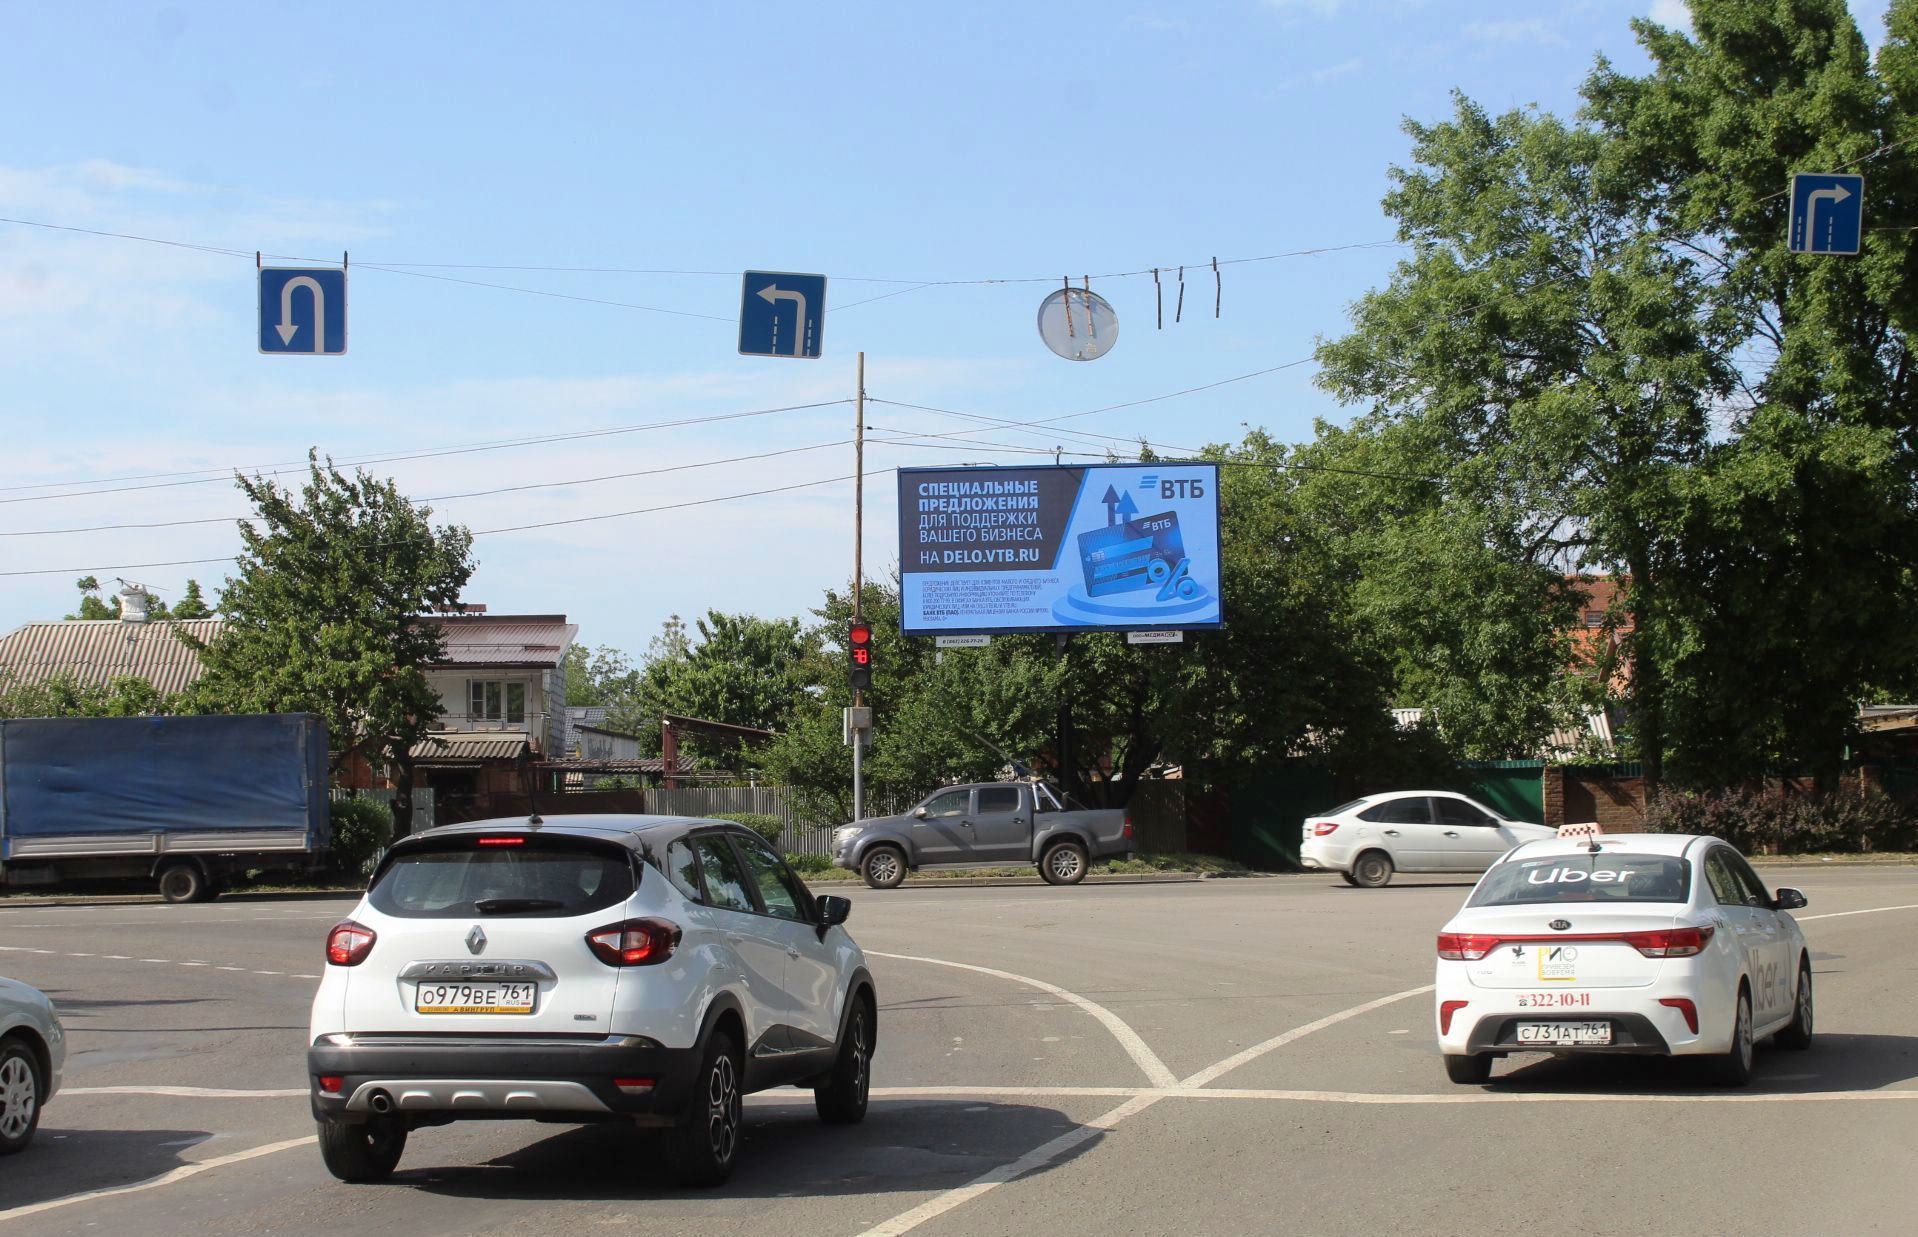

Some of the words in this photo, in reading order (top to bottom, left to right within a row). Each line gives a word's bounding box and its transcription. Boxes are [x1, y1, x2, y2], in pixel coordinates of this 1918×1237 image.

[918, 480, 1038, 497] СПЕЦИАЛЬНЫЕ
[1161, 479, 1204, 499] ВТБ
[918, 496, 1039, 513] ПРЕДЛОЖЕНИЯ
[919, 514, 947, 529] ДЛЯ
[951, 511, 1037, 528] ПОДДЕРЖКИ
[1152, 519, 1171, 531] ВТБ
[920, 529, 977, 543] ВАШЕГО
[981, 527, 1043, 542] БИЗНЕСА
[920, 551, 940, 564] НА
[943, 548, 1040, 564] DELO.VTB.RU
[1551, 920, 1569, 929] KIA
[423, 985, 497, 1005] О979ВЕ
[501, 984, 531, 1000] 761
[1530, 993, 1590, 1007] 322-10-11
[1521, 1024, 1581, 1040] С731АТ
[1583, 1023, 1608, 1036] 761
